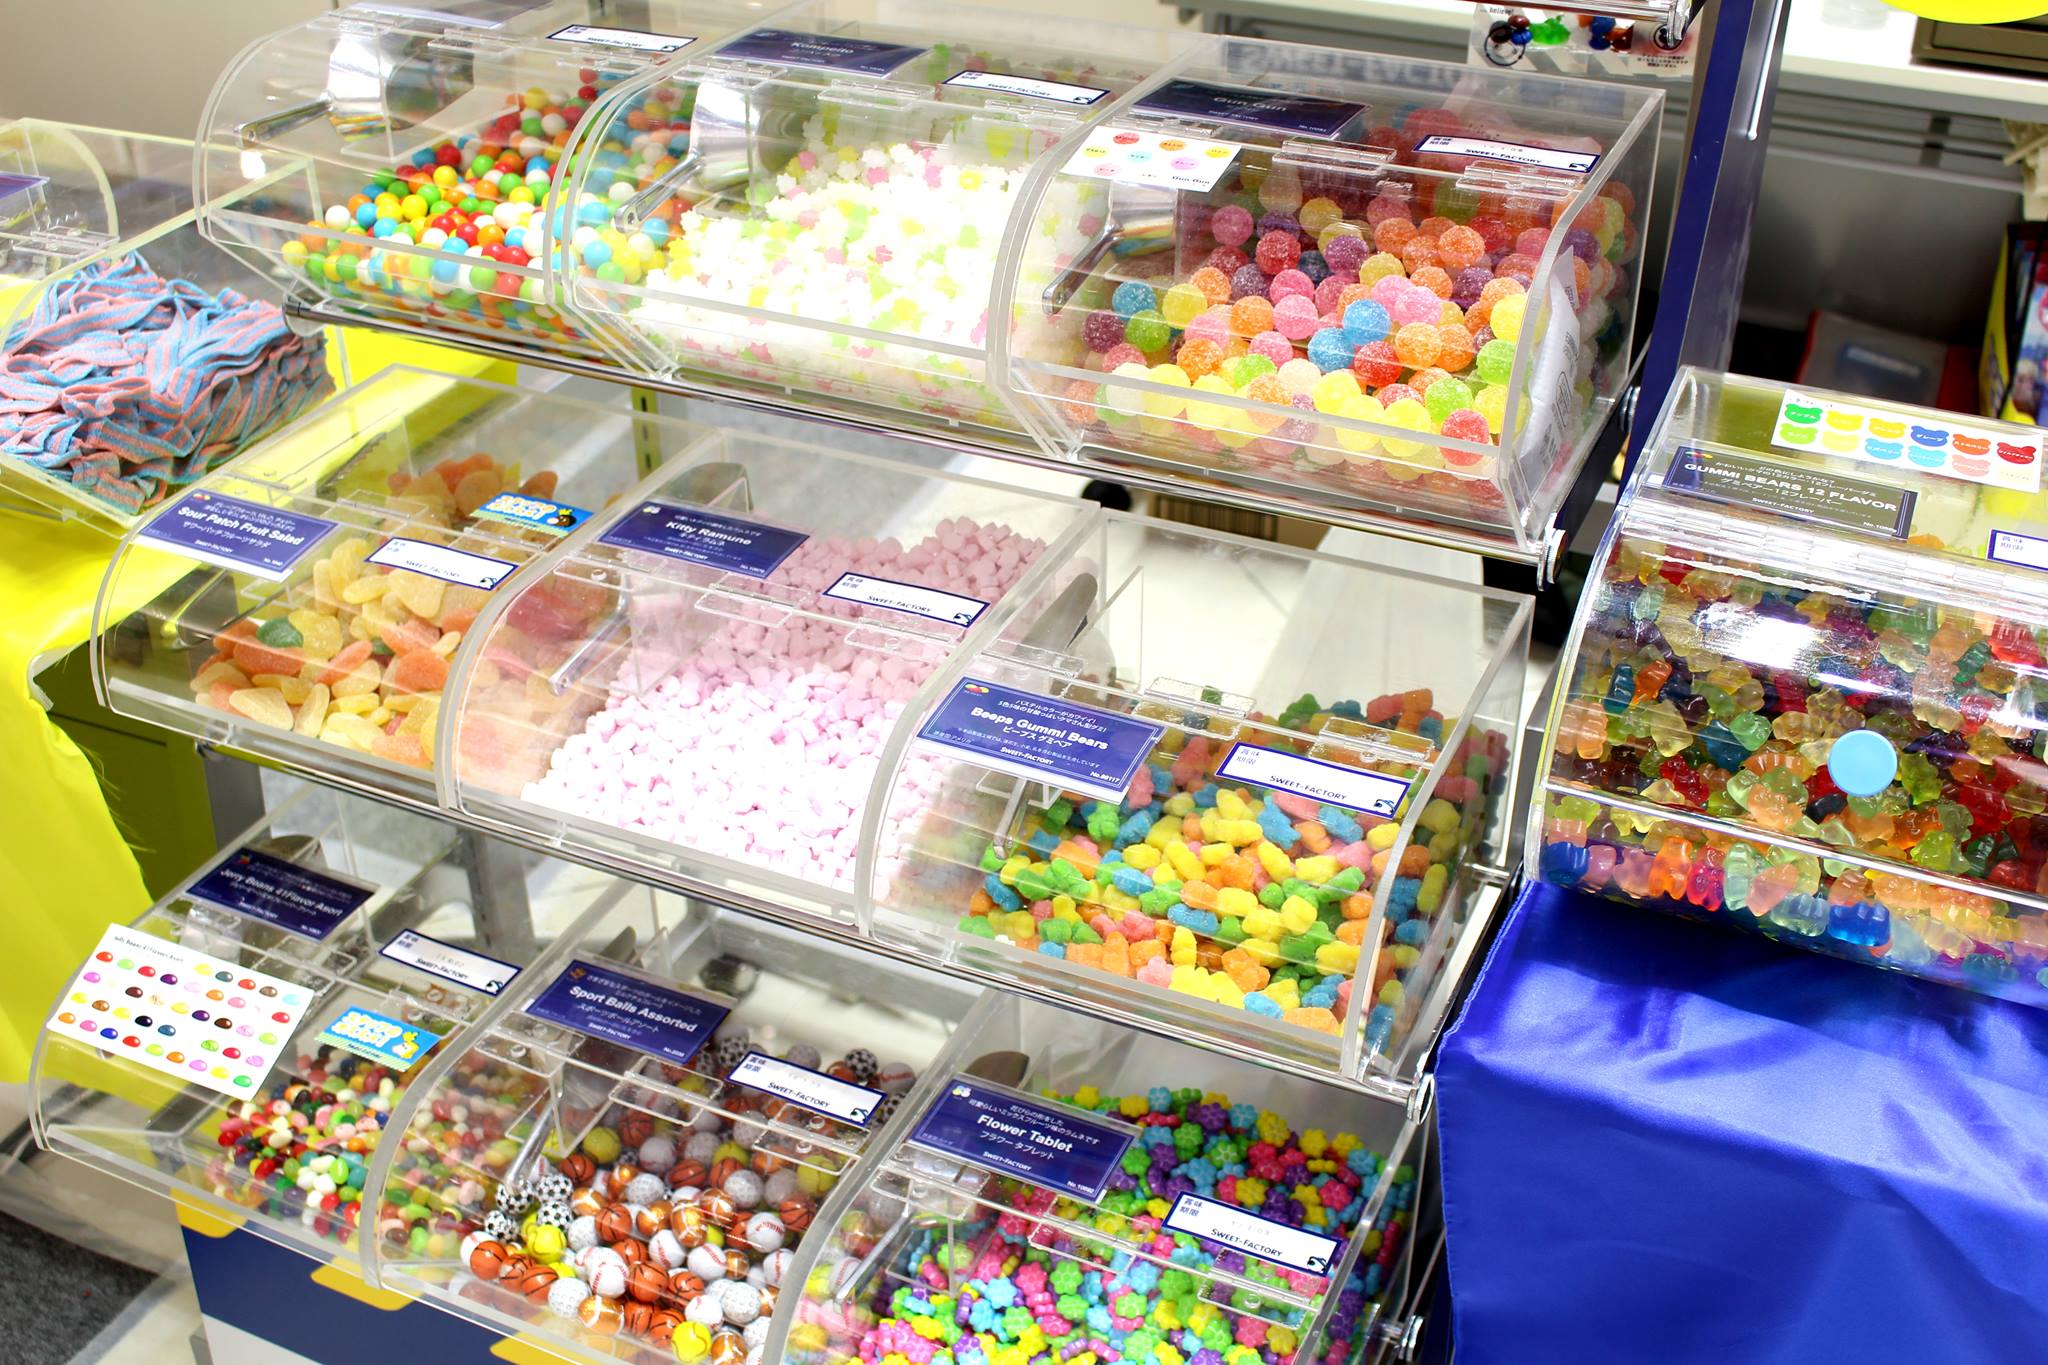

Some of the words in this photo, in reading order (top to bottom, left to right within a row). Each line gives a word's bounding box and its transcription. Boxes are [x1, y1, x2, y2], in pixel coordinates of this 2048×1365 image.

[1464, 148, 1542, 165] SWEET-FACTORY
[1683, 462, 1740, 479] GUMMI
[1744, 475, 1802, 491] BEARS
[1806, 487, 1825, 495] 12
[1828, 491, 1897, 511] FLAVOR
[1751, 497, 1814, 513] SWEET-FACTORY
[175, 506, 209, 519] Sour
[204, 513, 243, 528] Patch
[237, 522, 272, 536] Fruit
[265, 529, 306, 545] Salad
[663, 521, 698, 533] Kitty
[695, 528, 754, 545] Ramune
[867, 595, 932, 612] SWEET-FACTORY
[968, 706, 1016, 726] Beeps
[1014, 718, 1067, 738] Gummi
[1065, 731, 1110, 750] Bears
[999, 746, 1054, 765] SWEET-FACTORY
[1270, 775, 1347, 800] SWEET-FACTORY
[416, 958, 468, 979] SWEET-FACTORY
[567, 985, 607, 1004] Sport
[603, 996, 639, 1013] Balls
[636, 1007, 698, 1032] Assorted
[768, 1082, 830, 1107] SWEET-FACTORY
[976, 1114, 1028, 1137] Flower
[1026, 1130, 1074, 1152] Tablet
[981, 1151, 1032, 1171] SWEET-FACTORY
[1211, 1228, 1282, 1257] SWEET-FACTORY
